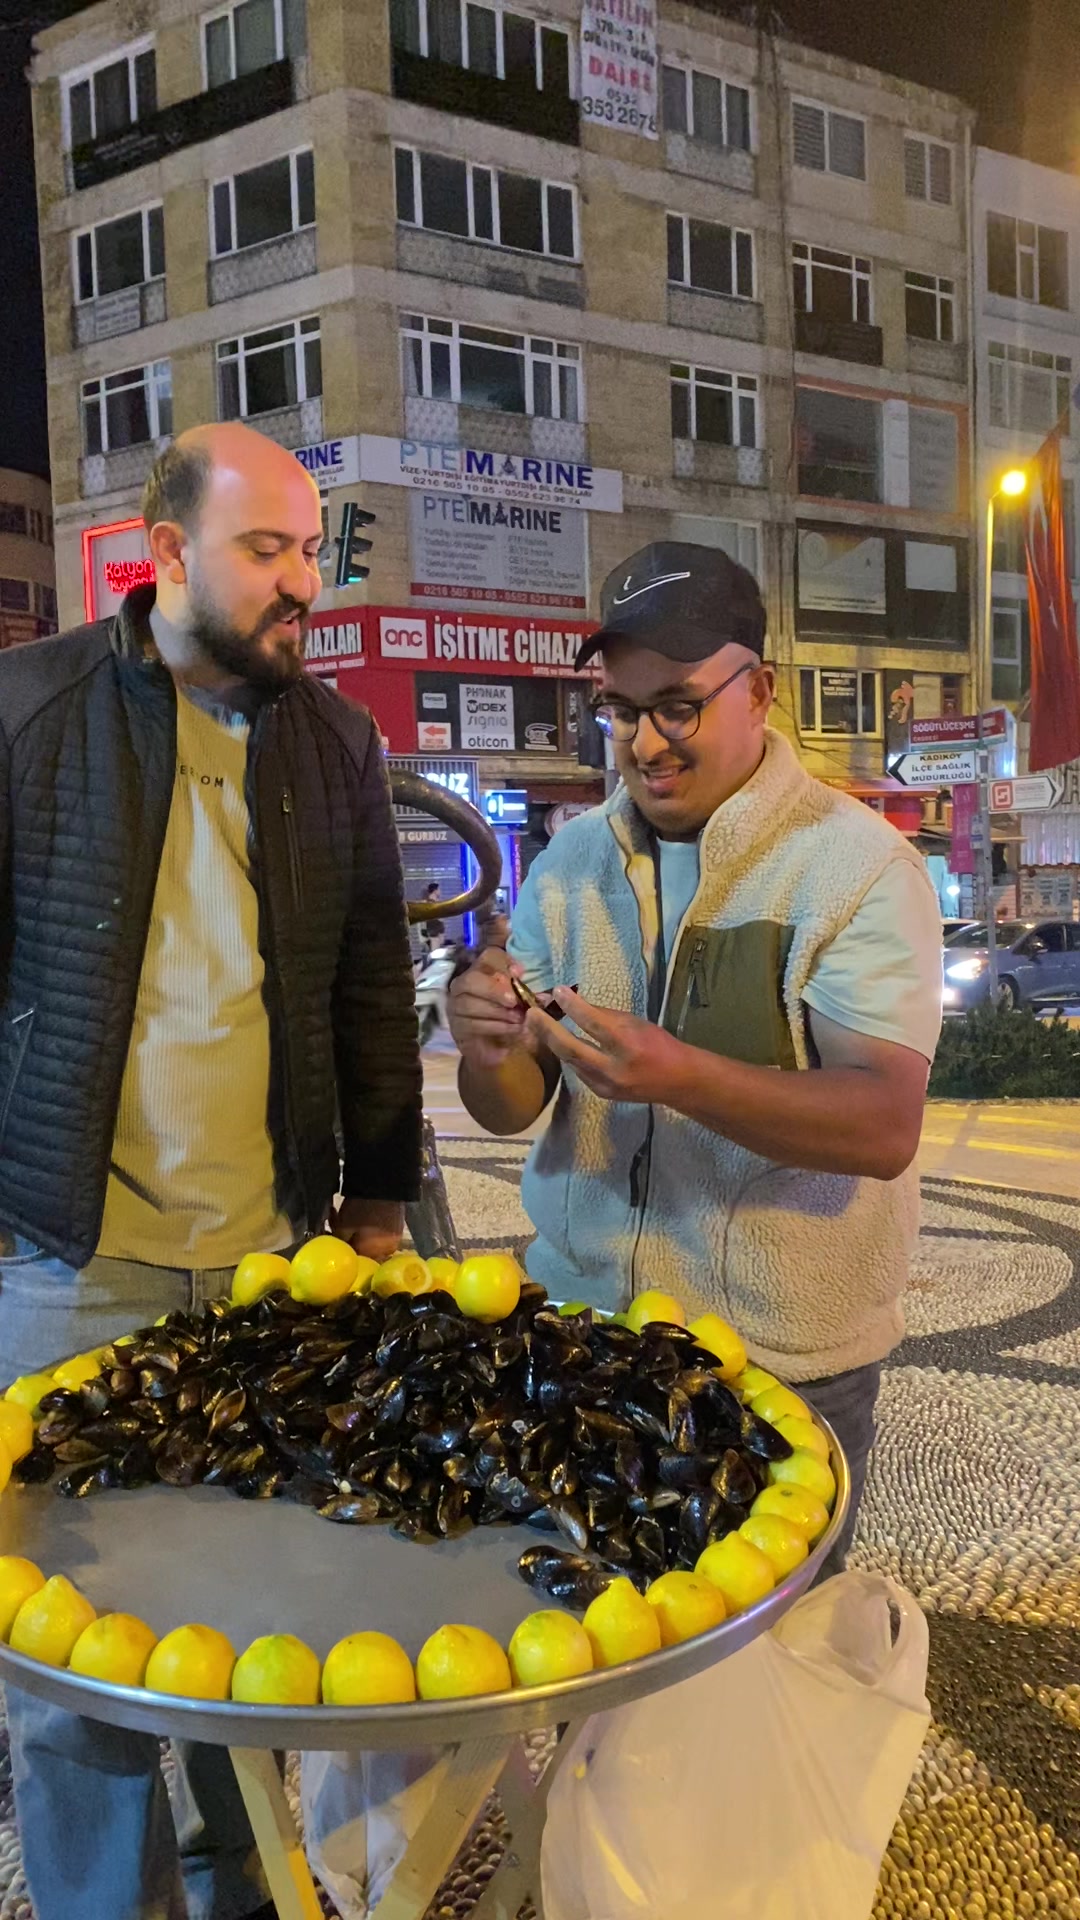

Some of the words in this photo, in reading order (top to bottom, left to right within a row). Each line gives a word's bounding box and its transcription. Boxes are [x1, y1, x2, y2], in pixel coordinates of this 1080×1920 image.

[400, 441, 457, 472] PTE
[423, 496, 464, 523] PTE
[470, 501, 562, 534] MARINE
[105, 560, 152, 580] Kalyon
[435, 615, 510, 662] İŞİTME
[467, 700, 507, 713] WIDEX
[467, 716, 508, 731] signia
[468, 736, 509, 749] oticon
[911, 764, 933, 773] İLÇE
[936, 761, 972, 771] SAĞLIK
